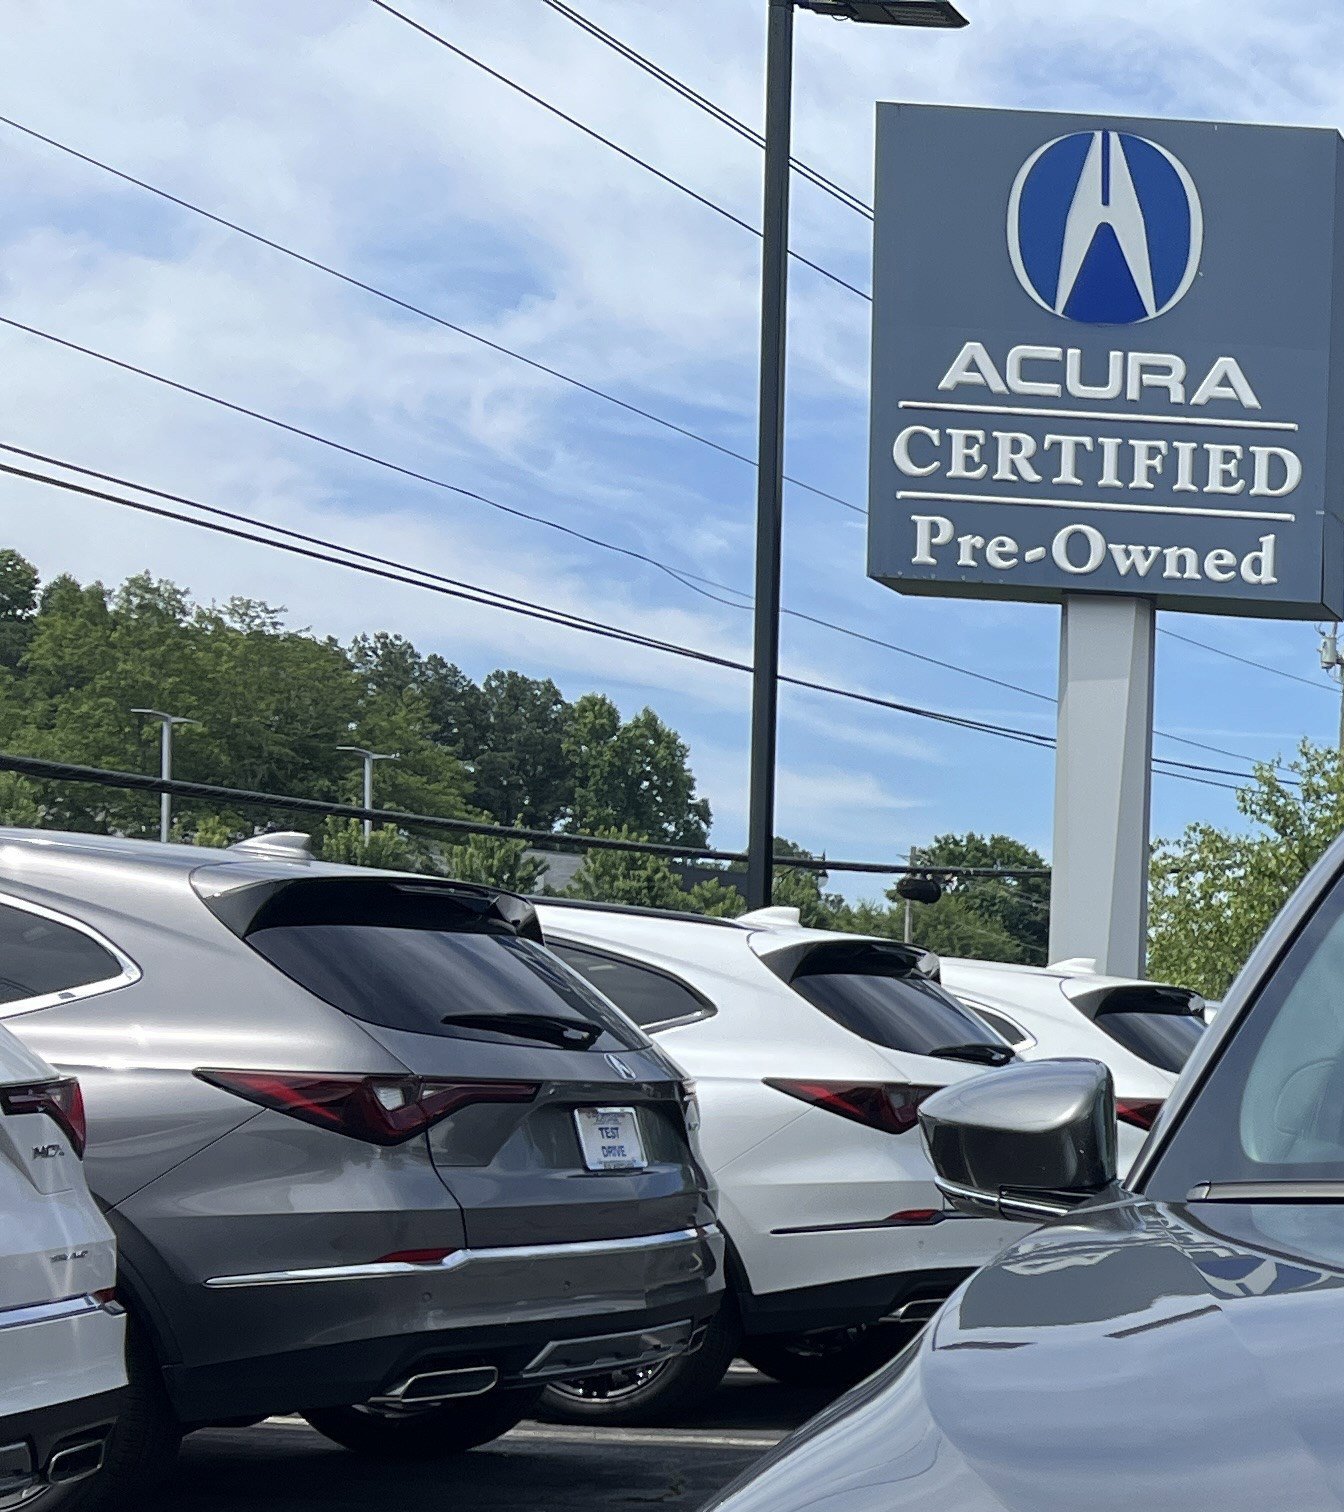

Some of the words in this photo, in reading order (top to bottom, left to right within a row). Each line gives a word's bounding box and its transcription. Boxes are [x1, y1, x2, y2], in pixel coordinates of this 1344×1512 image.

[937, 341, 1262, 410] ACURA
[892, 425, 1302, 497] CERTIFIED
[910, 514, 1278, 585] Pre-Owned
[598, 1126, 620, 1139] TEST
[601, 1145, 627, 1158] DRIVE
